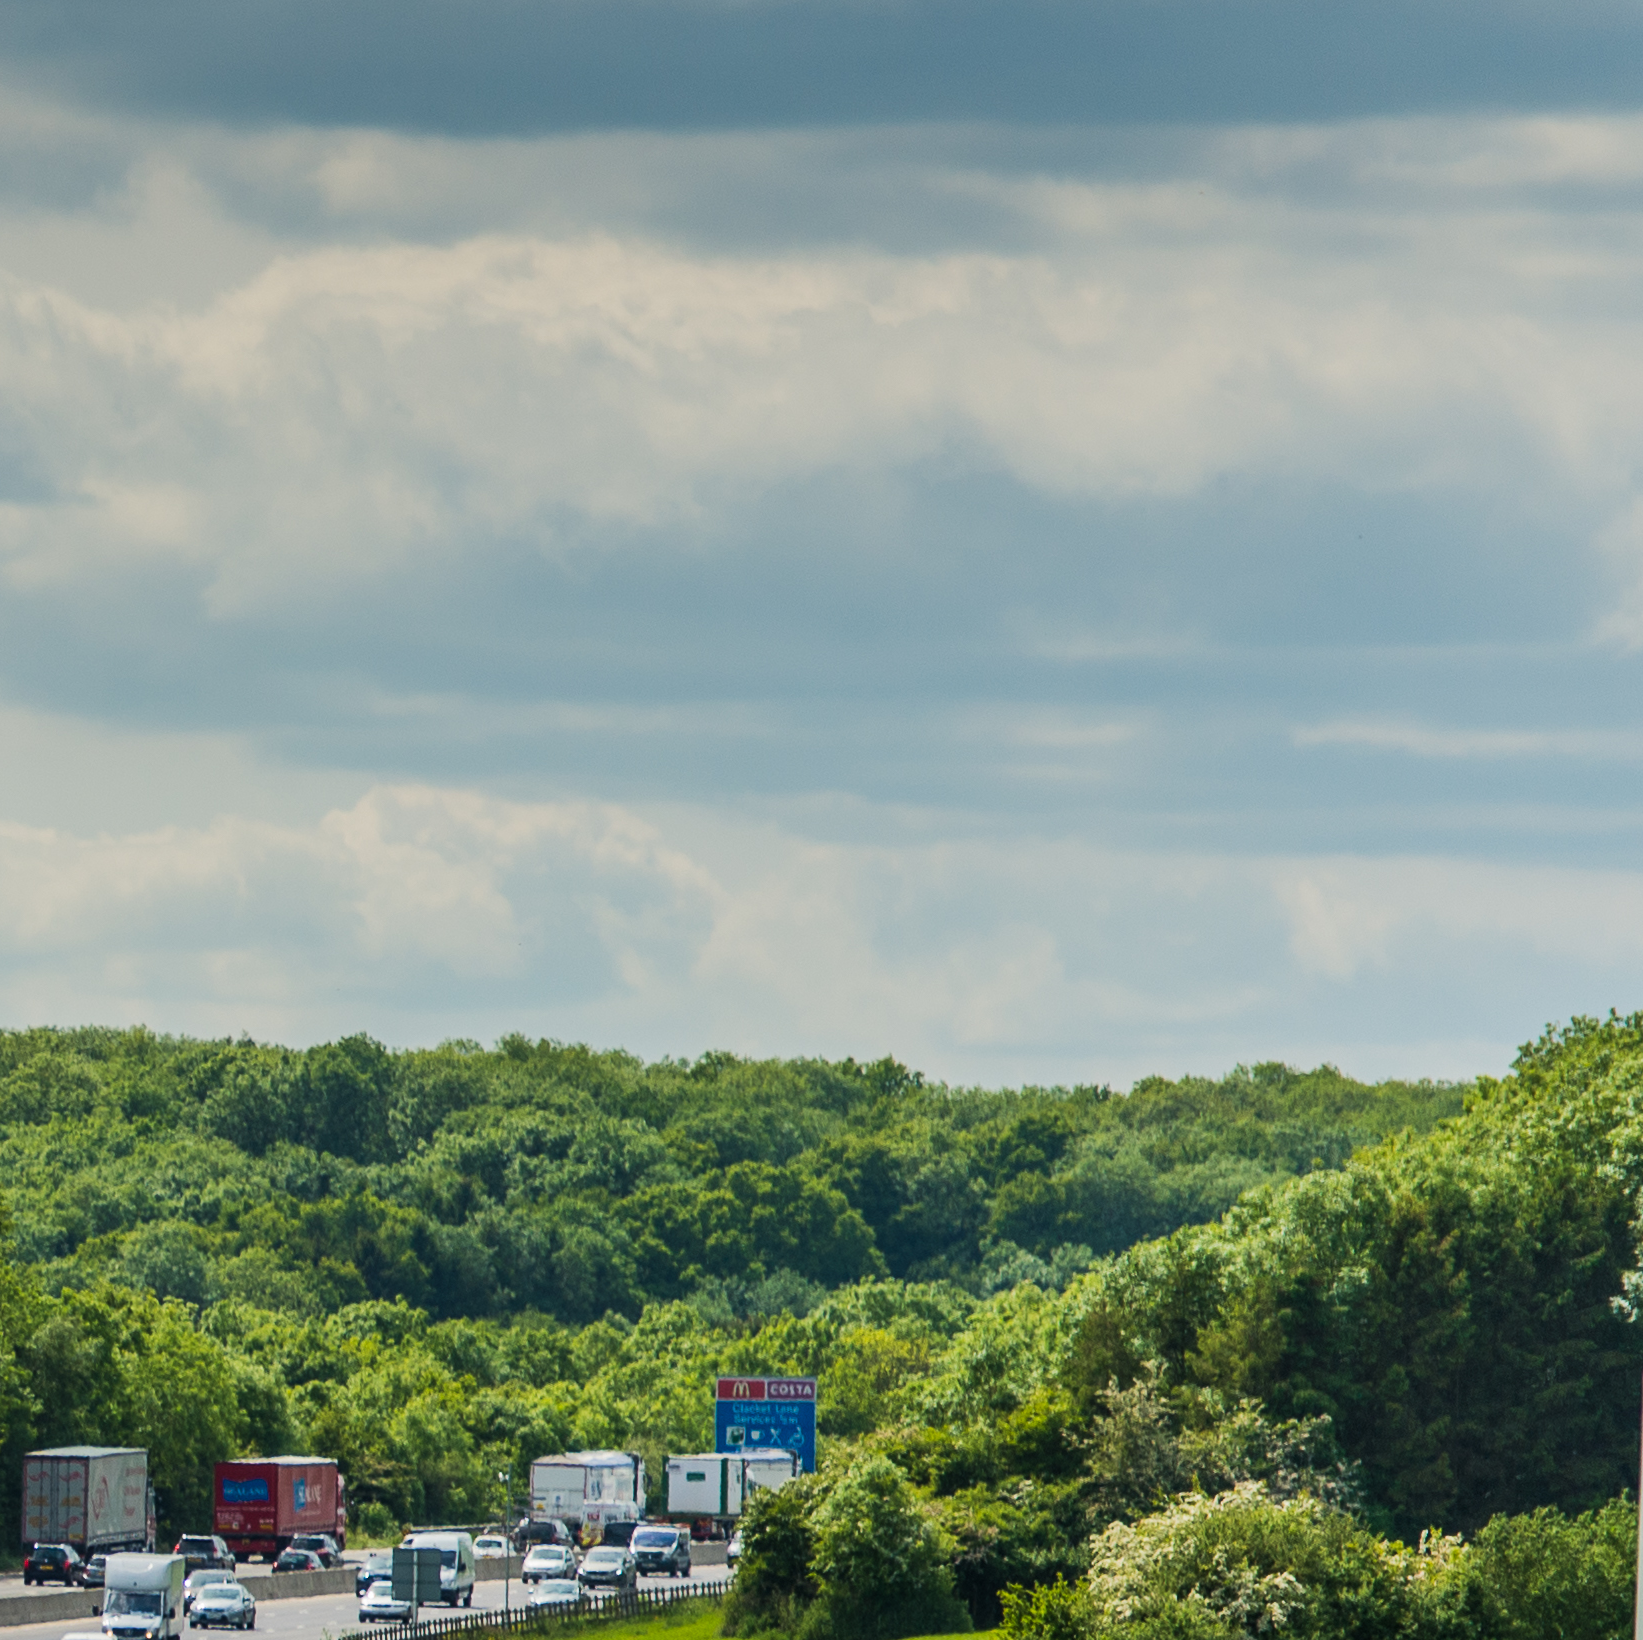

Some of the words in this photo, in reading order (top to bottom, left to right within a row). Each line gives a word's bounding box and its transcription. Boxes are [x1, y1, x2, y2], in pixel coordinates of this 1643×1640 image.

[770, 1384, 812, 1396] COSTA
[732, 1403, 771, 1414] Clacket
[775, 1404, 799, 1414] Lane
